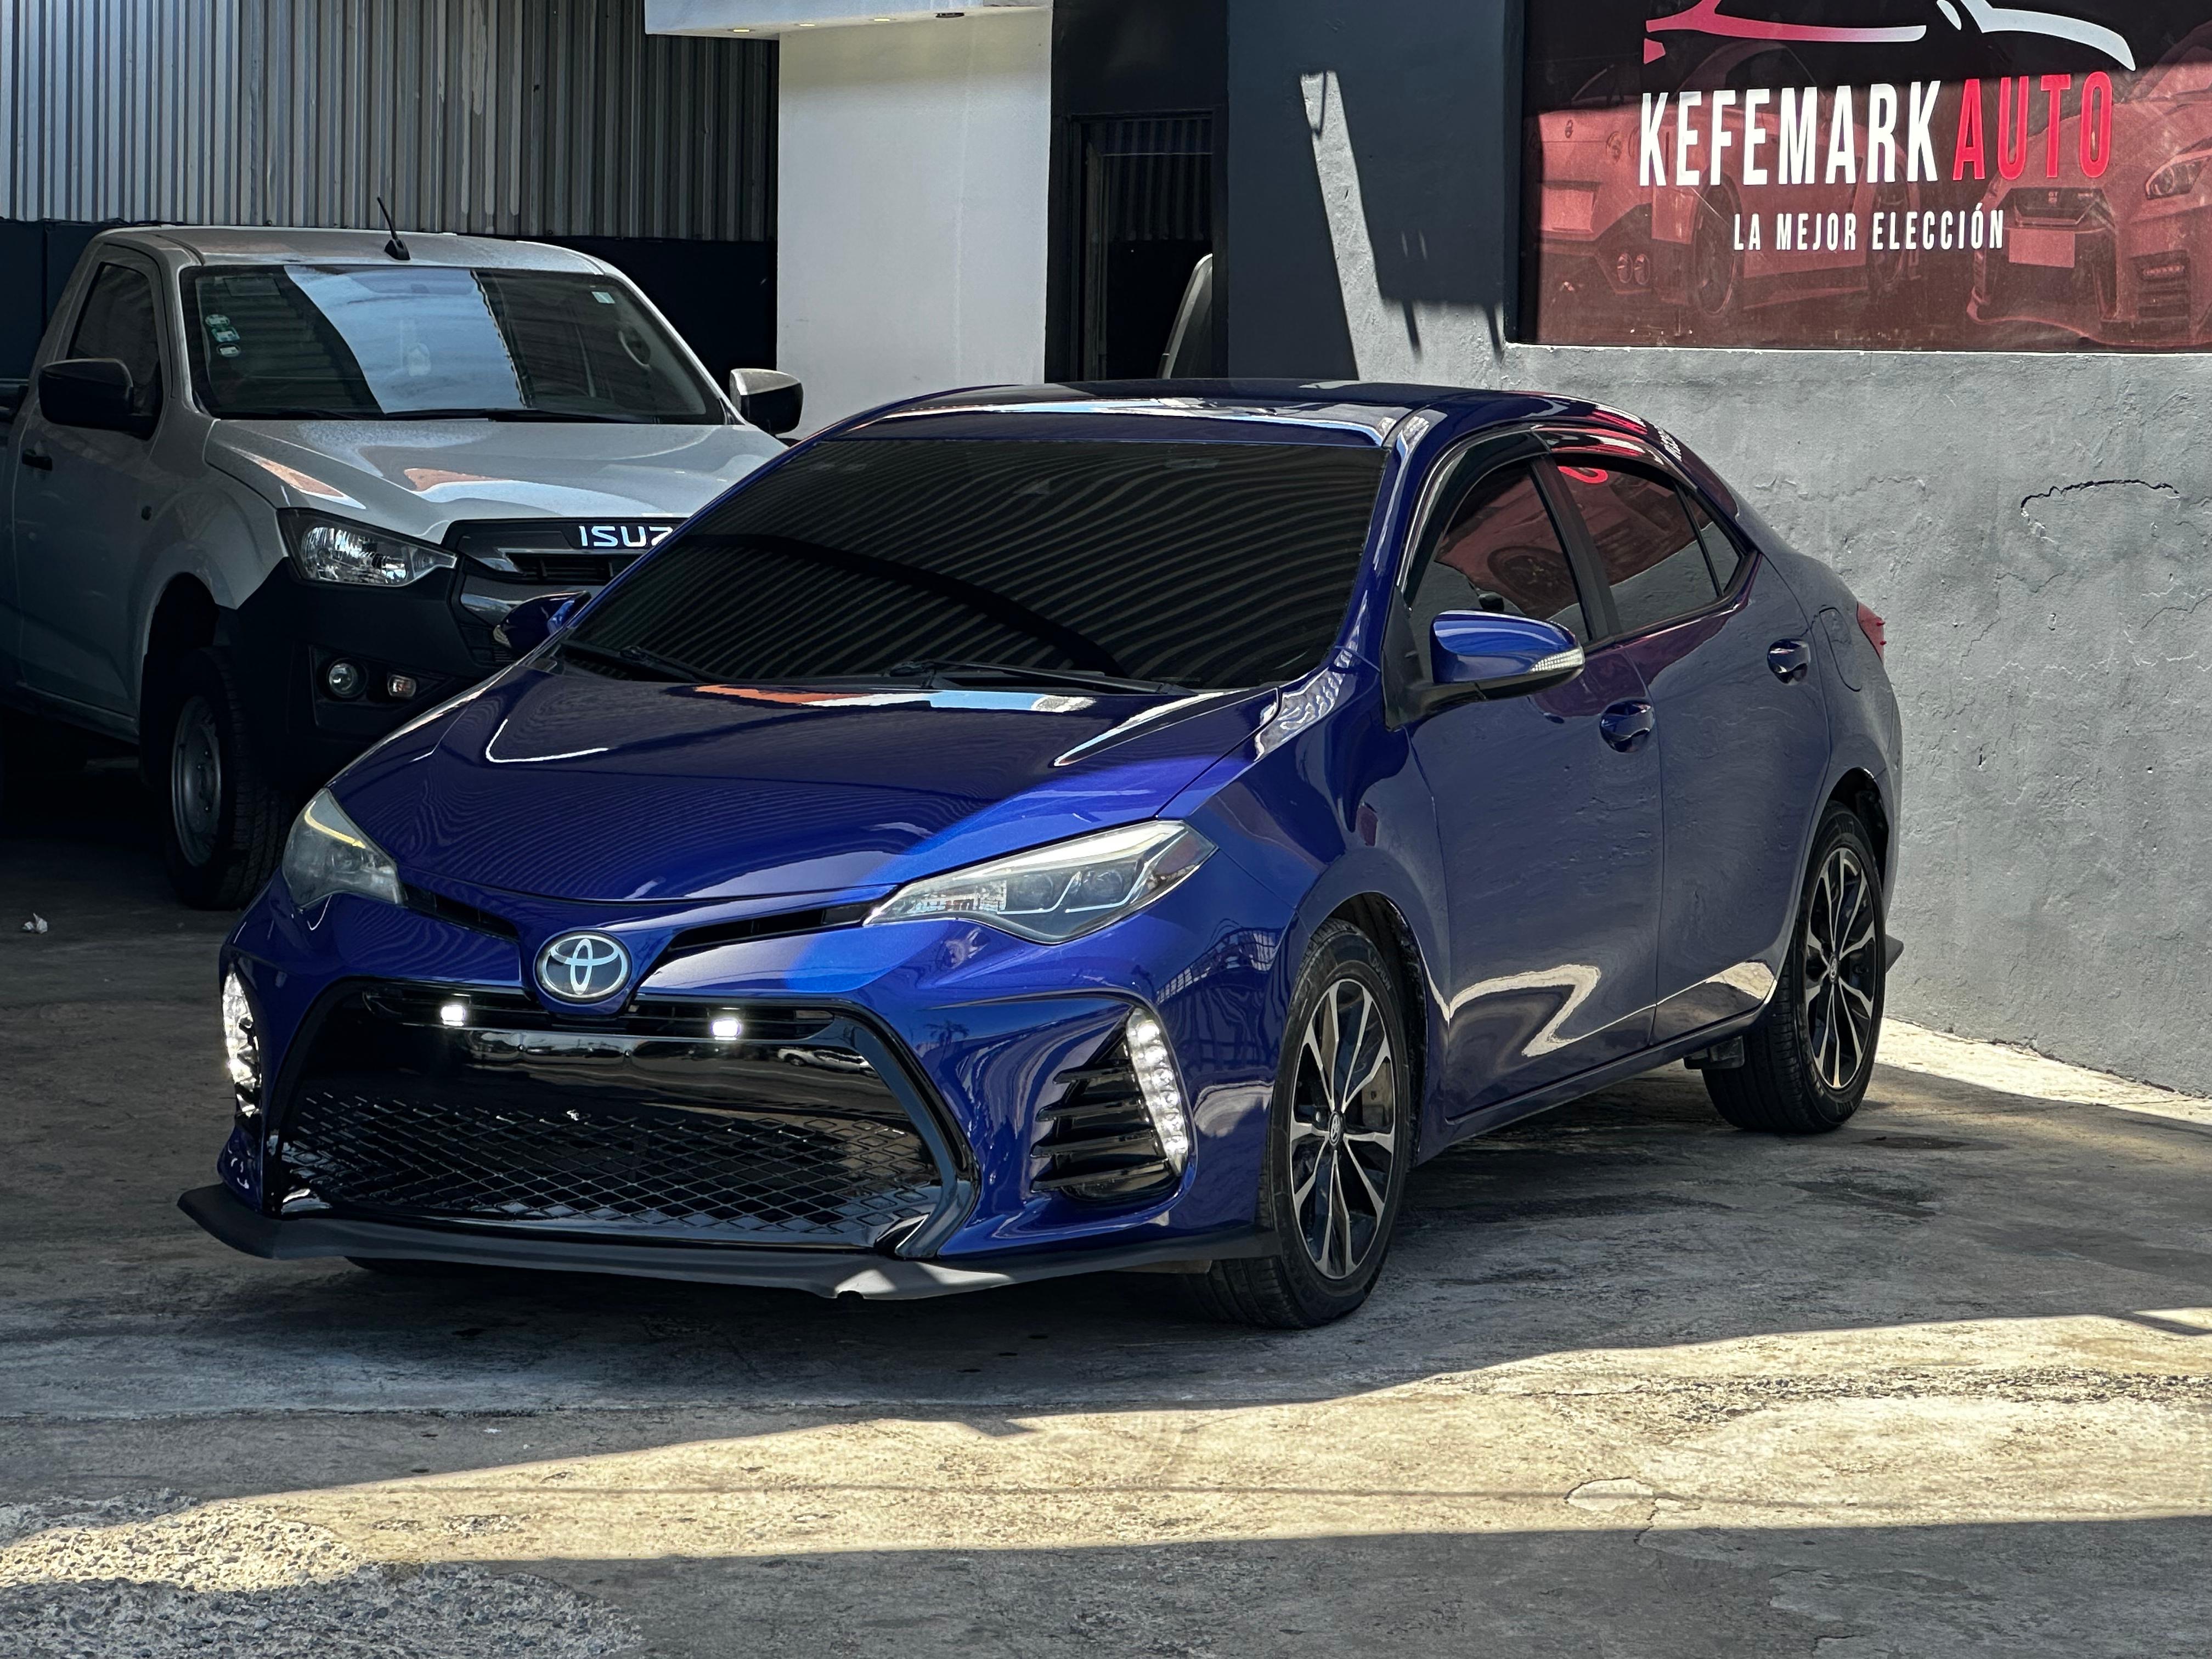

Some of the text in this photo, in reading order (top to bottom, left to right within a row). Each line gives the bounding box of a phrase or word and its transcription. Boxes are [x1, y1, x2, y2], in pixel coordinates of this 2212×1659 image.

[1639, 71, 2113, 187] KEFEMARK AUTO
[1734, 202, 2004, 251] LA MEJOR ELECCIÓN
